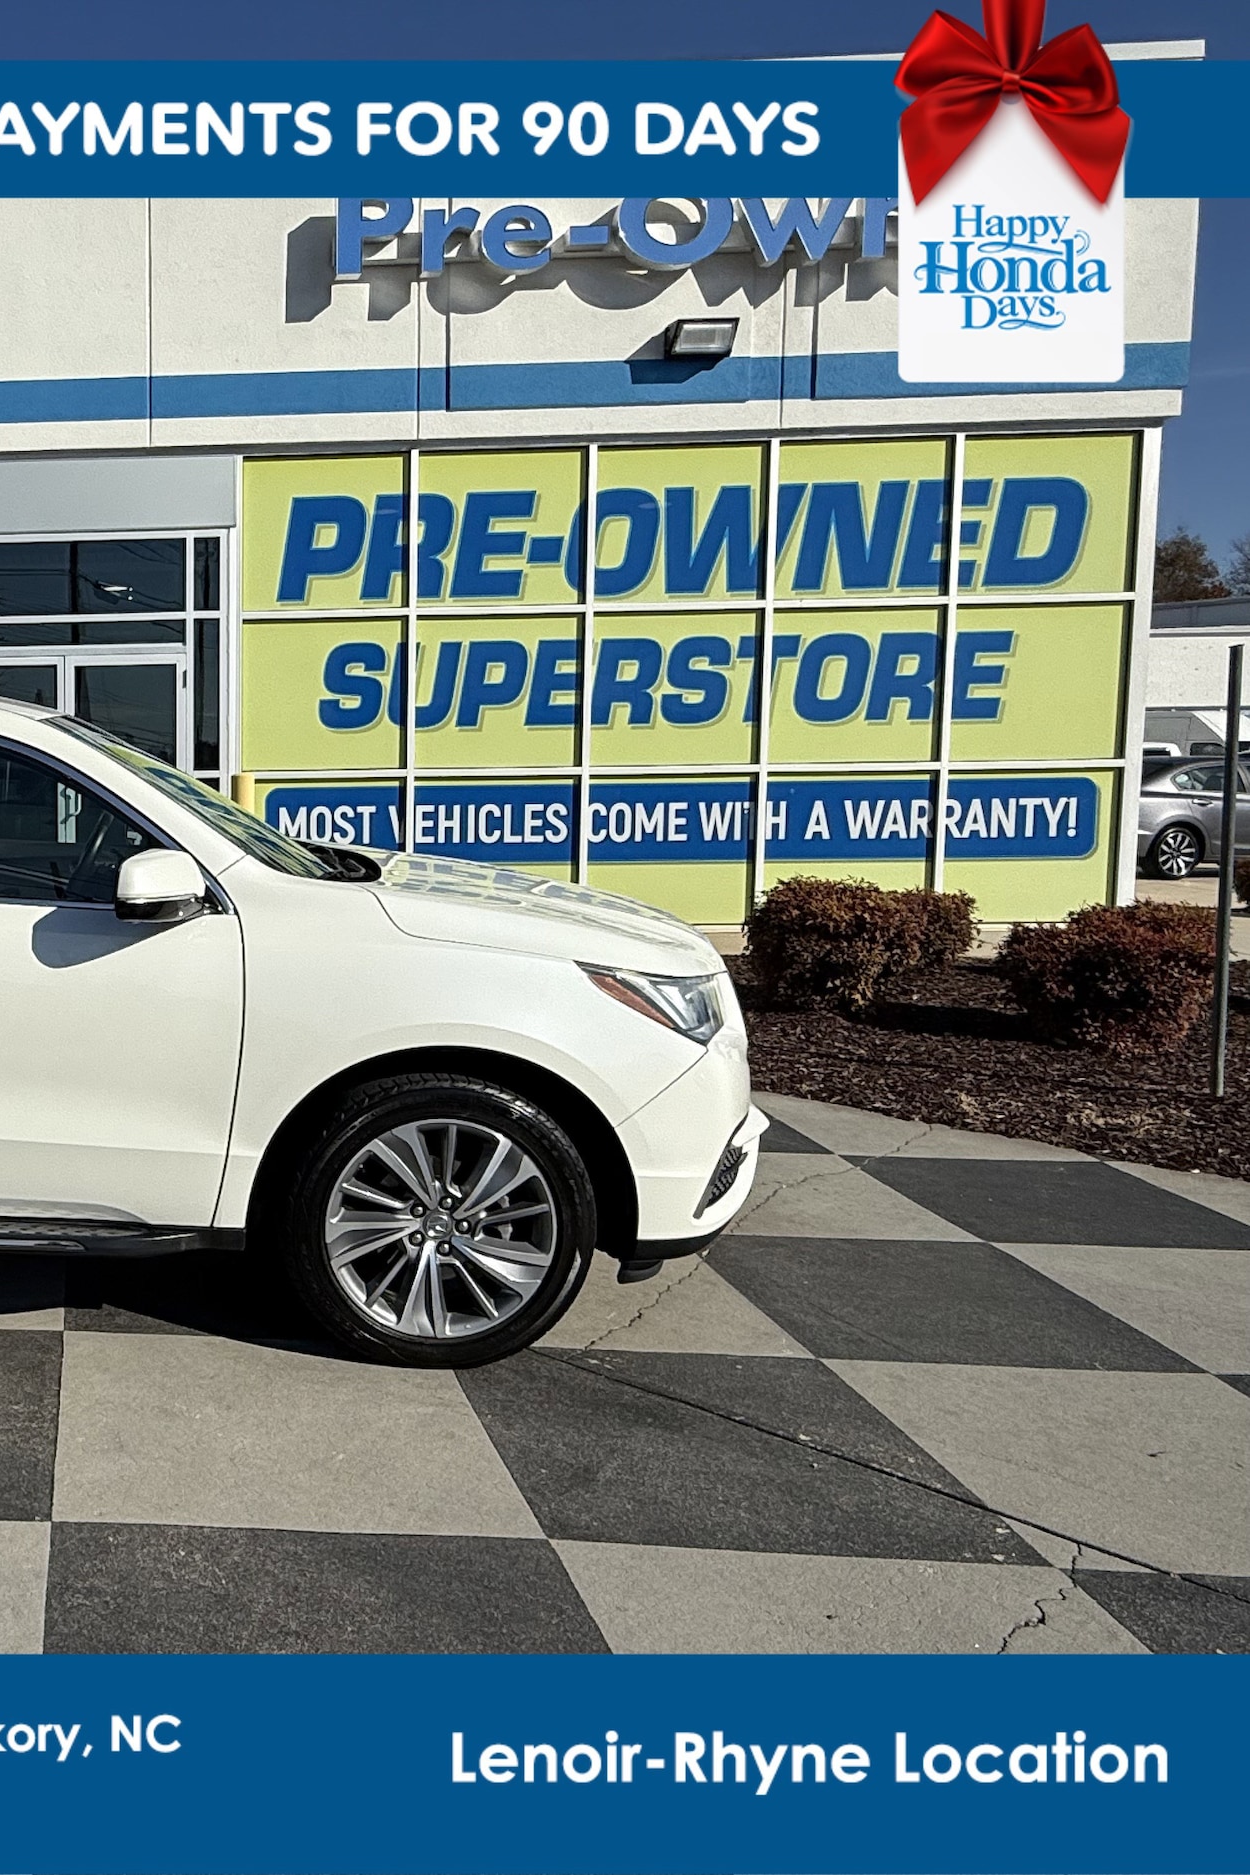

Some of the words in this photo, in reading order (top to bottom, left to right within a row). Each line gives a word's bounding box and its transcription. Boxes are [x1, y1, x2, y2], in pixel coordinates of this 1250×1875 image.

[275, 476, 1089, 602] PRE-OWNED
[318, 630, 1015, 730] SUPERSTORE
[277, 804, 377, 845] MOST
[388, 802, 569, 844] VEHICLES
[586, 801, 688, 843] COME
[698, 800, 788, 841] WITH
[803, 799, 831, 841] A
[843, 796, 1079, 841] WARRANTY!
